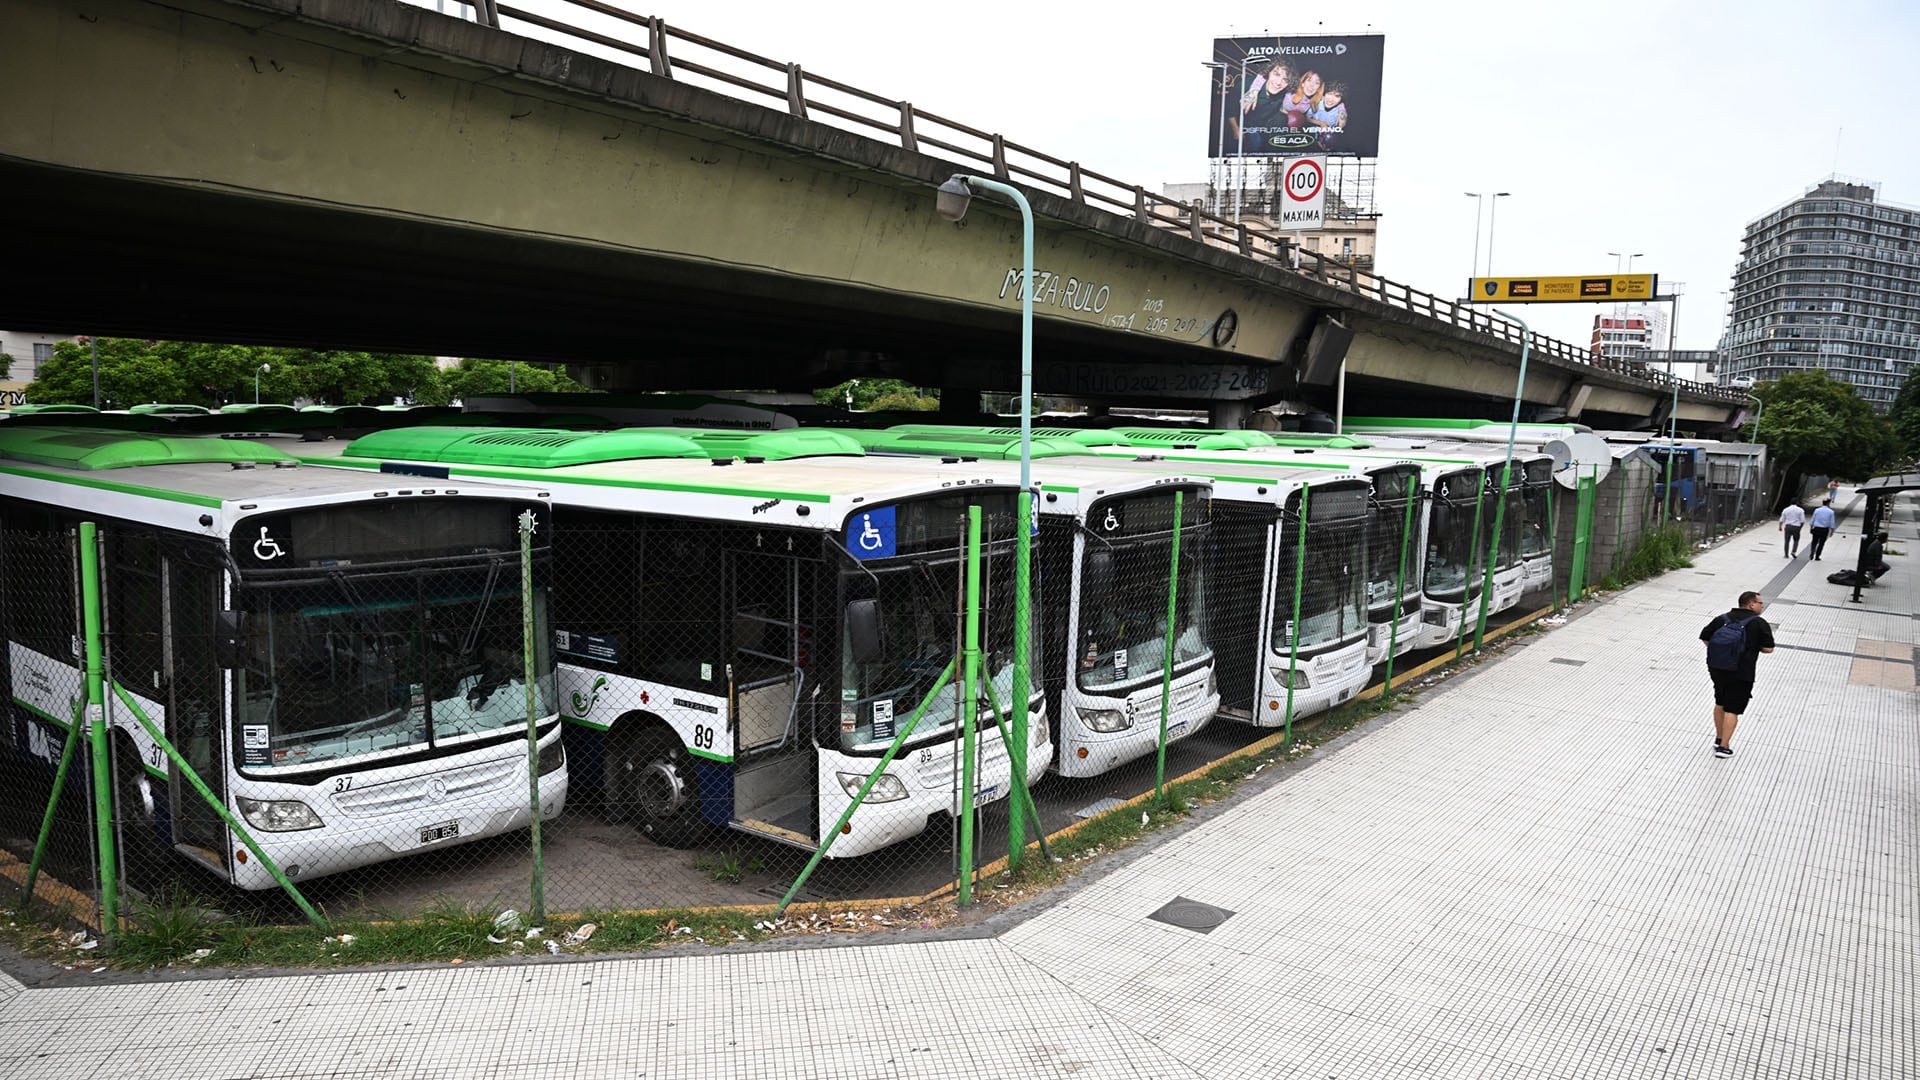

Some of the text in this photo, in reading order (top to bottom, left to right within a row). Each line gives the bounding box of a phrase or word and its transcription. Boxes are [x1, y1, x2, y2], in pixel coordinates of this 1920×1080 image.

[1247, 45, 1333, 55] ALTOAVELLANEDA
[1241, 126, 1289, 134] DISFRUTAR
[1289, 126, 1301, 134] EL
[1291, 171, 1317, 190] 100
[1283, 209, 1320, 223] MAXIMA
[1143, 298, 1164, 313] 2013
[1144, 316, 1169, 333] 2015
[694, 723, 714, 749] 89
[151, 743, 163, 768] 37
[920, 748, 932, 763] 89
[335, 776, 353, 792] 37
[441, 825, 458, 838] 852
